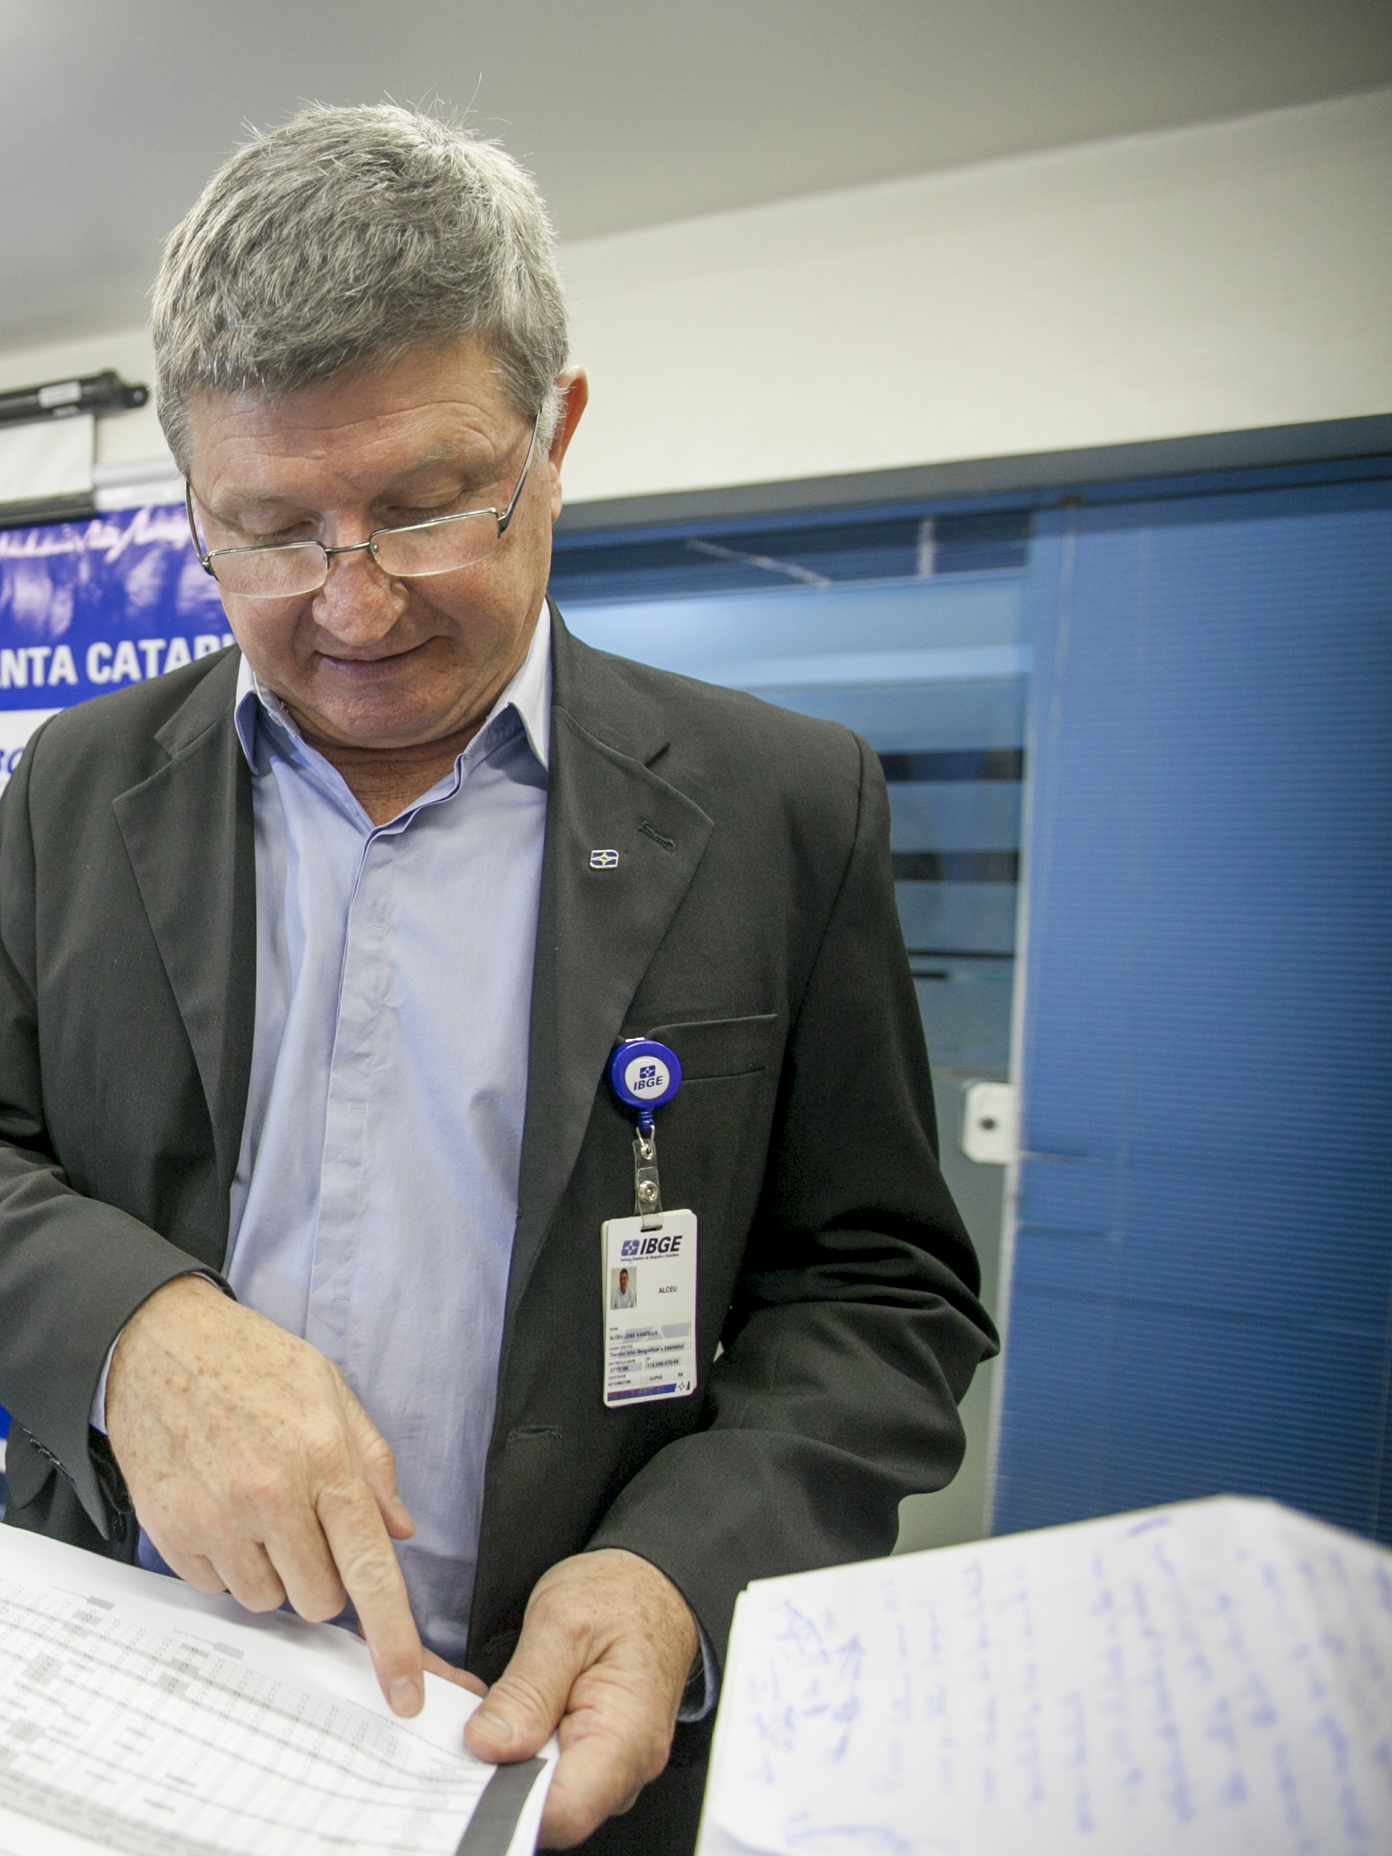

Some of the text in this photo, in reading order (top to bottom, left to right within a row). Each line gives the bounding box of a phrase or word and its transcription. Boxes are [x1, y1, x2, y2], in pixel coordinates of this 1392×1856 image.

[86, 632, 238, 685] CATAR
[633, 1075, 664, 1091] IBGE
[640, 1236, 682, 1255] IBGE
[658, 1286, 677, 1294] ALCEU
